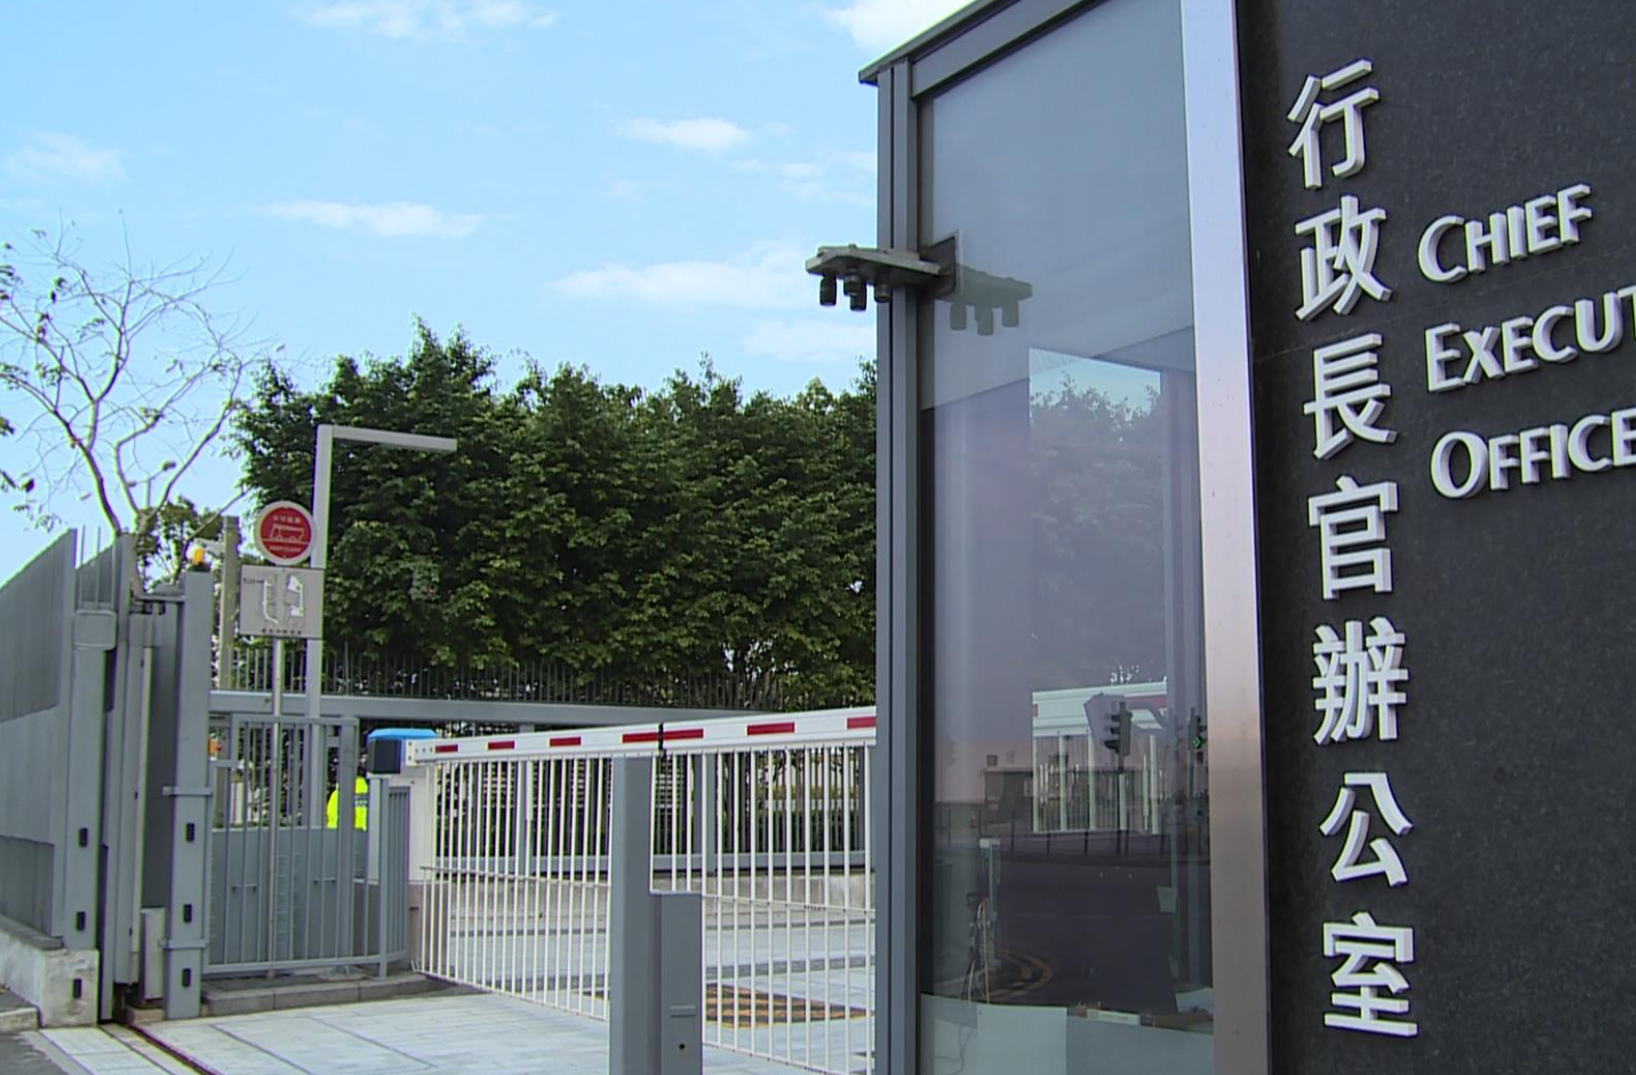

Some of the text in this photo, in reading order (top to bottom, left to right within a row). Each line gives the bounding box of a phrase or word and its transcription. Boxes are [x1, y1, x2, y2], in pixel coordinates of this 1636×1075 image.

[1417, 183, 1592, 282] CHIEF
[1287, 58, 1419, 1037] 行政長官辦公室
